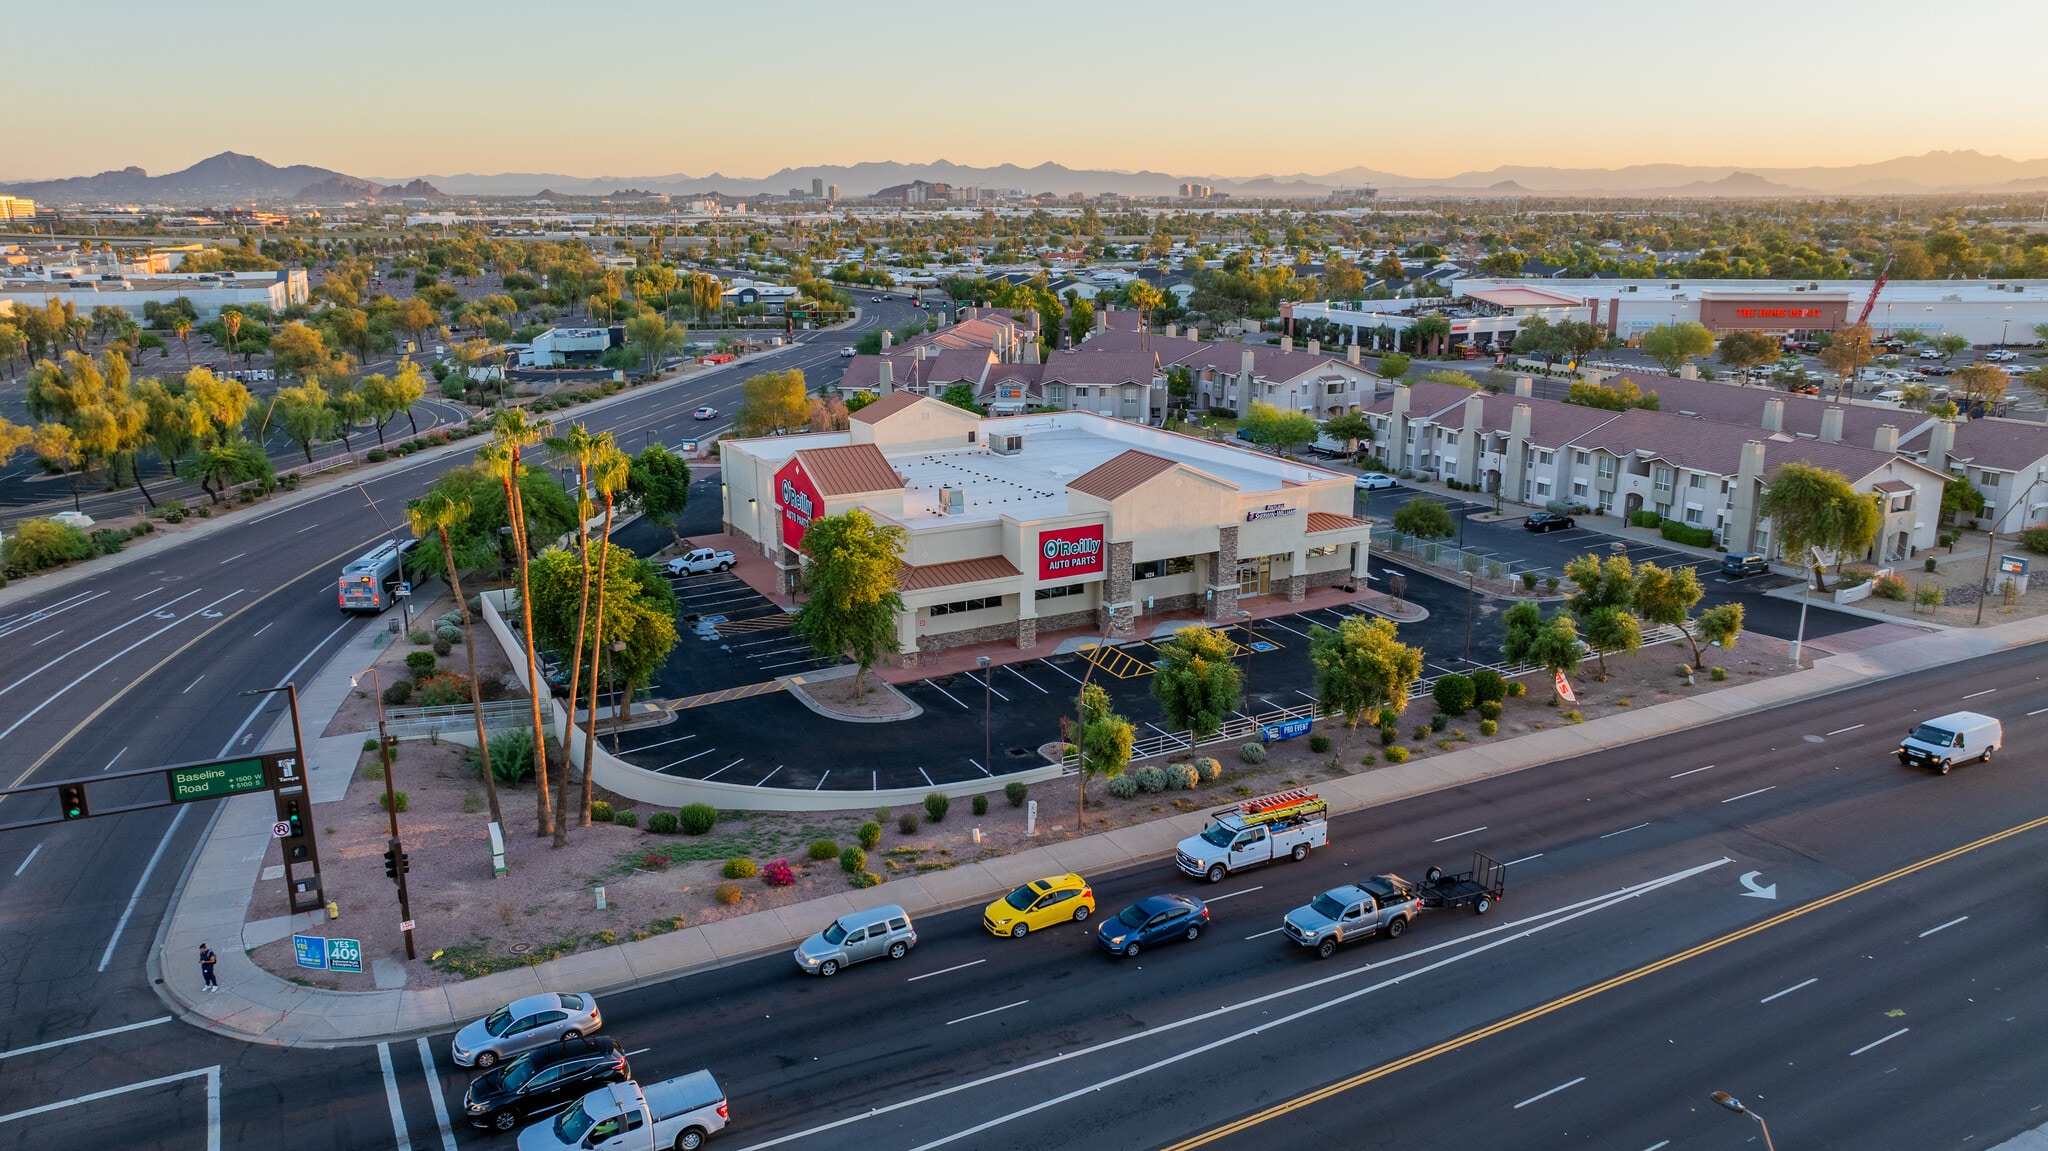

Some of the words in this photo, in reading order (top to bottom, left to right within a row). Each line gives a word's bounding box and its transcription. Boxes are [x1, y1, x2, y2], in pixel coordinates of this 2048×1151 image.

[1044, 538, 1101, 559] O'Reilly
[1049, 560, 1070, 570] AUTO
[1071, 556, 1096, 567] PARTS
[1283, 726, 1294, 735] PRO
[1294, 722, 1309, 732] EVENT
[176, 770, 226, 784] Baseline
[178, 782, 209, 794] Road
[236, 781, 253, 789] 5100
[334, 941, 349, 949] YES
[331, 947, 359, 961] 409
